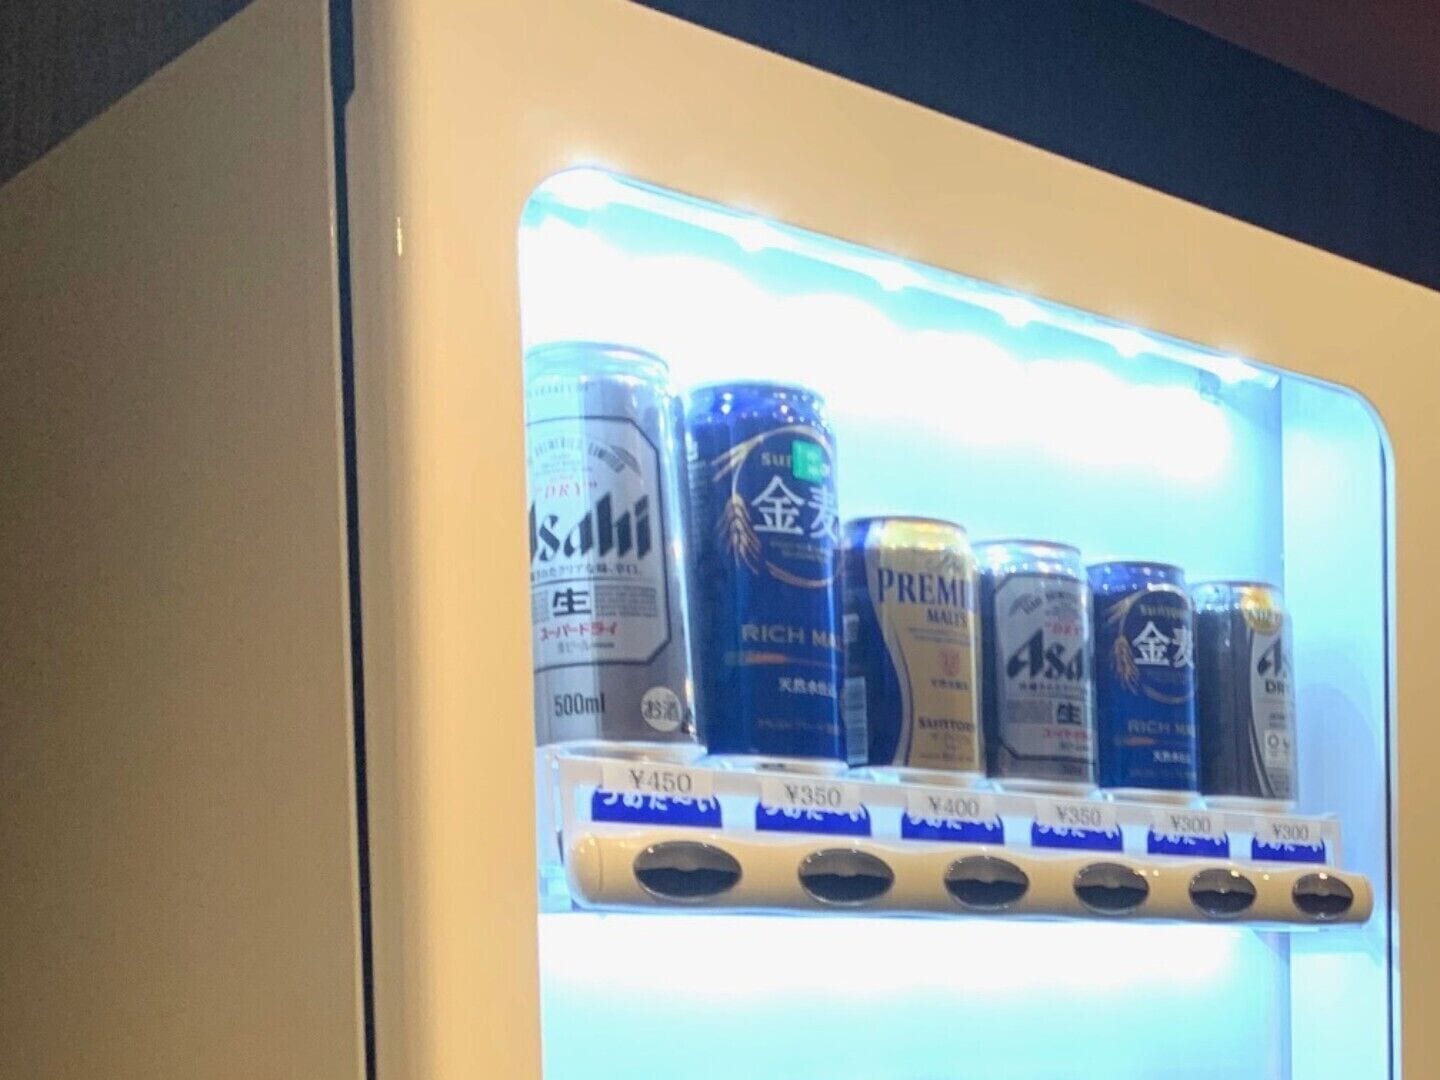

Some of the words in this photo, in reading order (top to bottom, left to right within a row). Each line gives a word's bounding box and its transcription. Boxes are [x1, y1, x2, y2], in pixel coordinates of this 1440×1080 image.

[751, 475, 841, 542] 金麦
[552, 587, 592, 617] 生
[742, 623, 804, 643] RICH
[554, 693, 606, 718] 500ml
[631, 768, 693, 794] ¥450
[785, 783, 842, 808] ¥350
[929, 796, 980, 818] ¥400
[1056, 805, 1101, 827] ¥350
[1170, 814, 1212, 834] ¥300
[1272, 823, 1309, 841] ¥300
